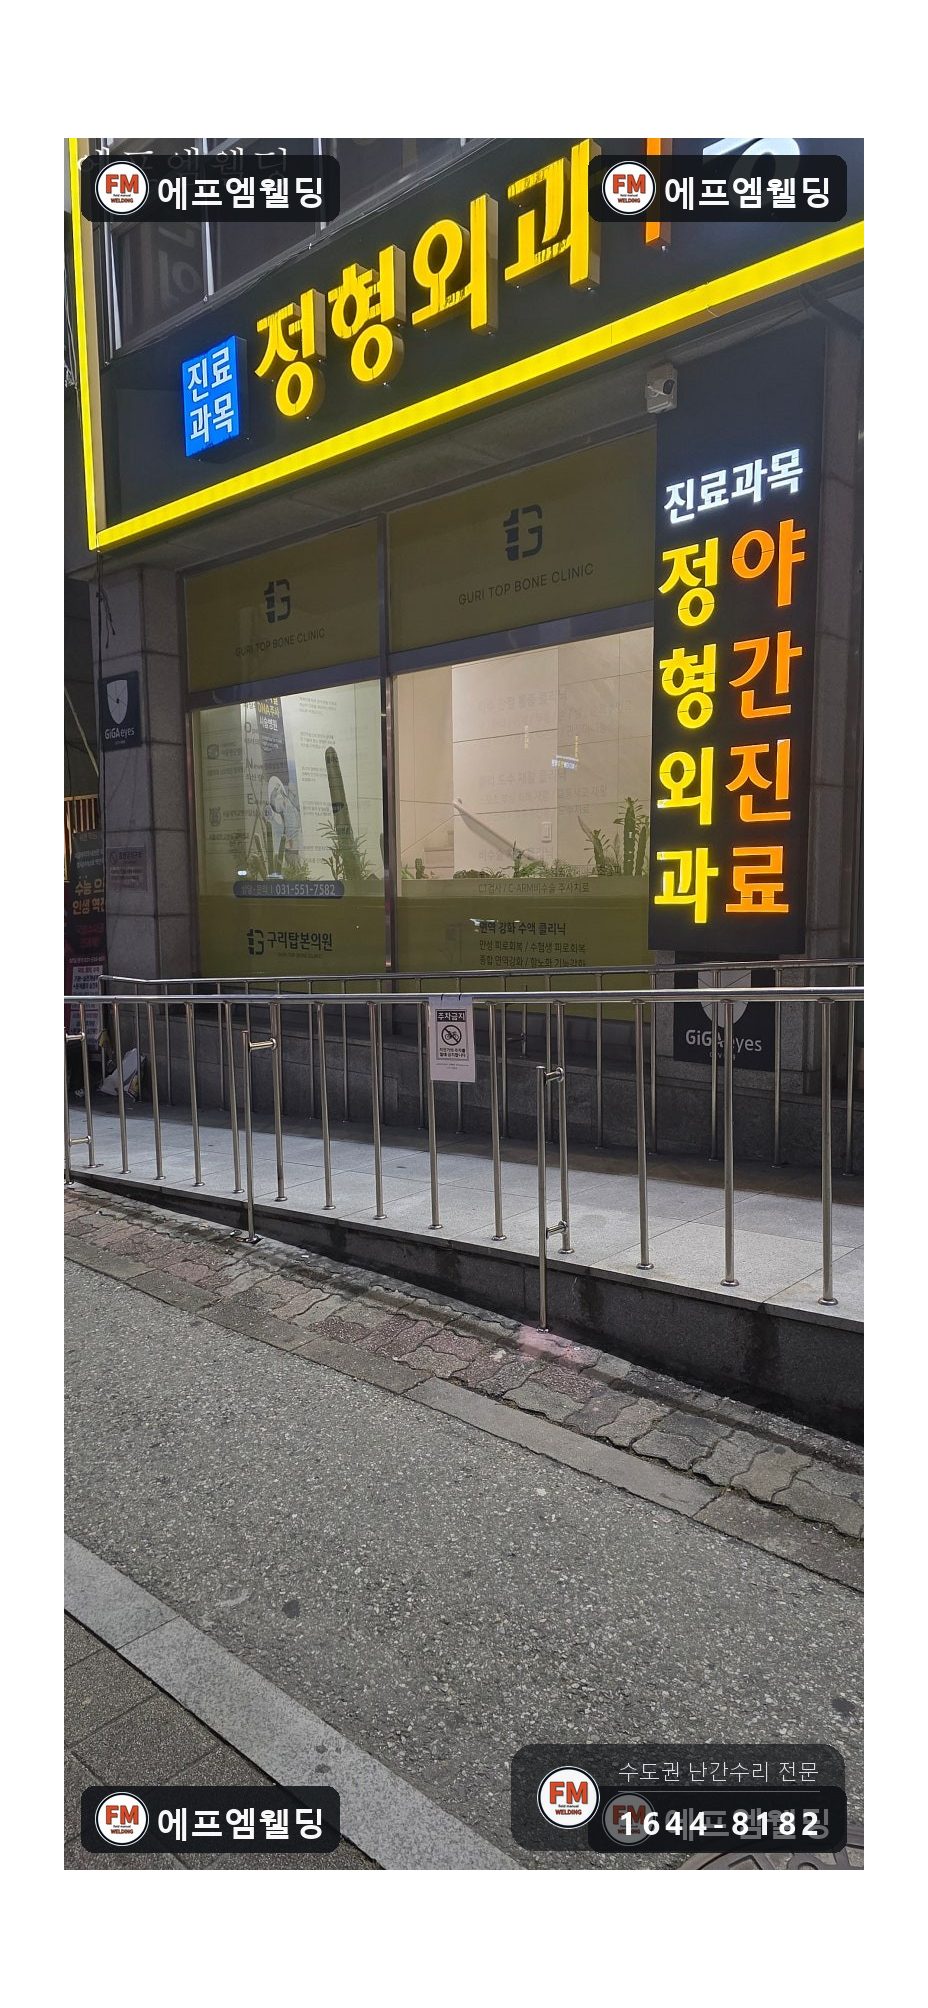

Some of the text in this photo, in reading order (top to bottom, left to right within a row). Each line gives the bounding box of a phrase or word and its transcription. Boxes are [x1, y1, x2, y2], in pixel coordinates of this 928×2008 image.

[187, 347, 233, 403] 진료
[189, 393, 235, 444] 과목
[663, 447, 803, 525] 진료과목
[458, 562, 594, 606] GURI TOP BONE CLINIC
[273, 634, 295, 649] BONE
[297, 627, 325, 644] CLINIC
[654, 536, 719, 925] 정형외과
[725, 518, 806, 915] 야간진료
[275, 884, 336, 896] 031-551-7582
[267, 932, 333, 952] 구리탑본의원
[538, 922, 567, 936] 클리닉
[438, 1012, 465, 1021] 주차금지
